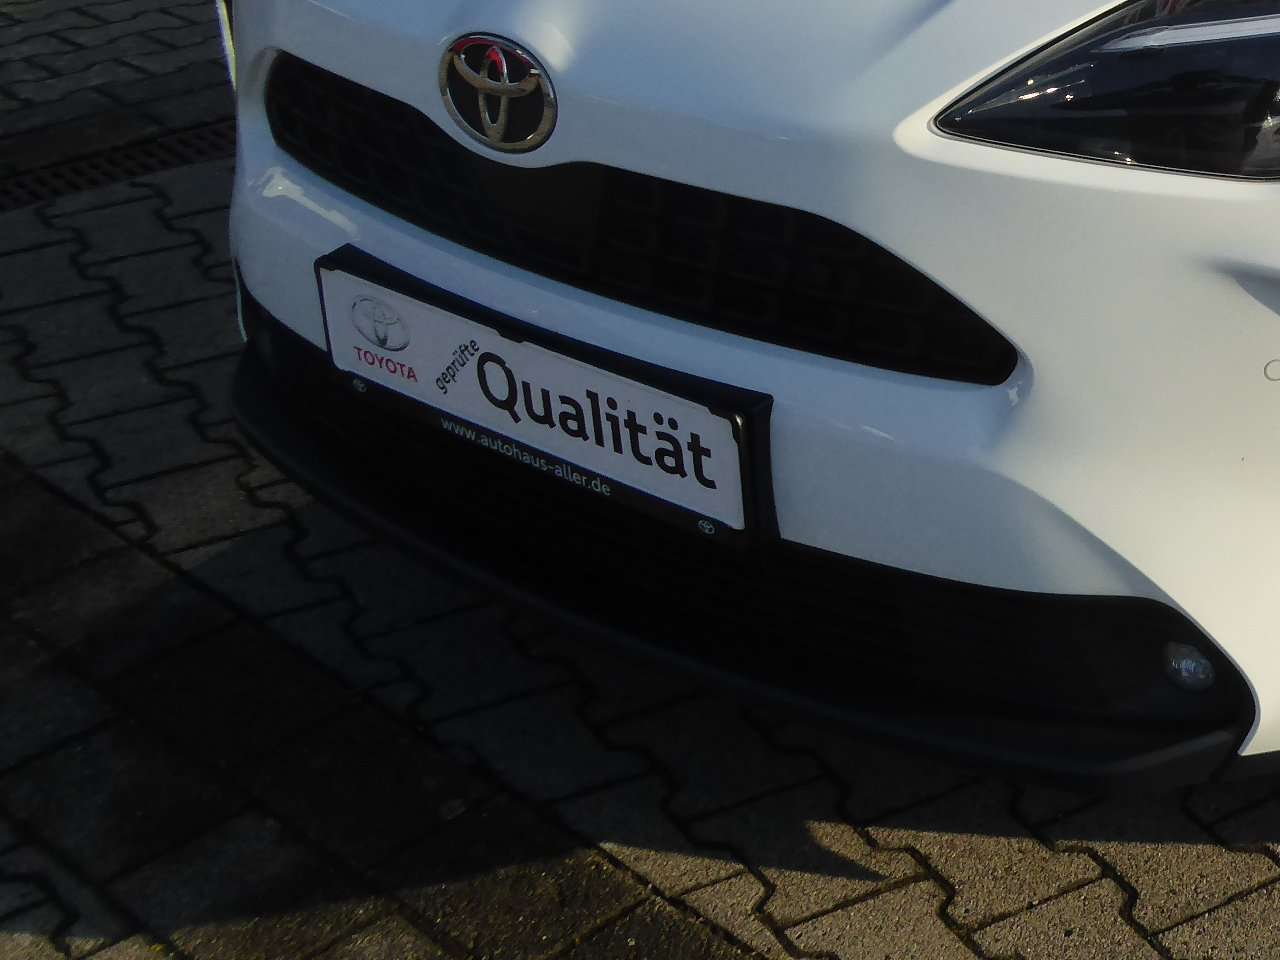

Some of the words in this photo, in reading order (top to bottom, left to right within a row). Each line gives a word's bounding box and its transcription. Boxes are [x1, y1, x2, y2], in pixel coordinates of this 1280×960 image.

[353, 345, 418, 383] TOYOTA
[435, 339, 480, 395] geprüfte
[476, 351, 718, 490] Qualität
[440, 415, 612, 495] www.autohaus-aller.de
